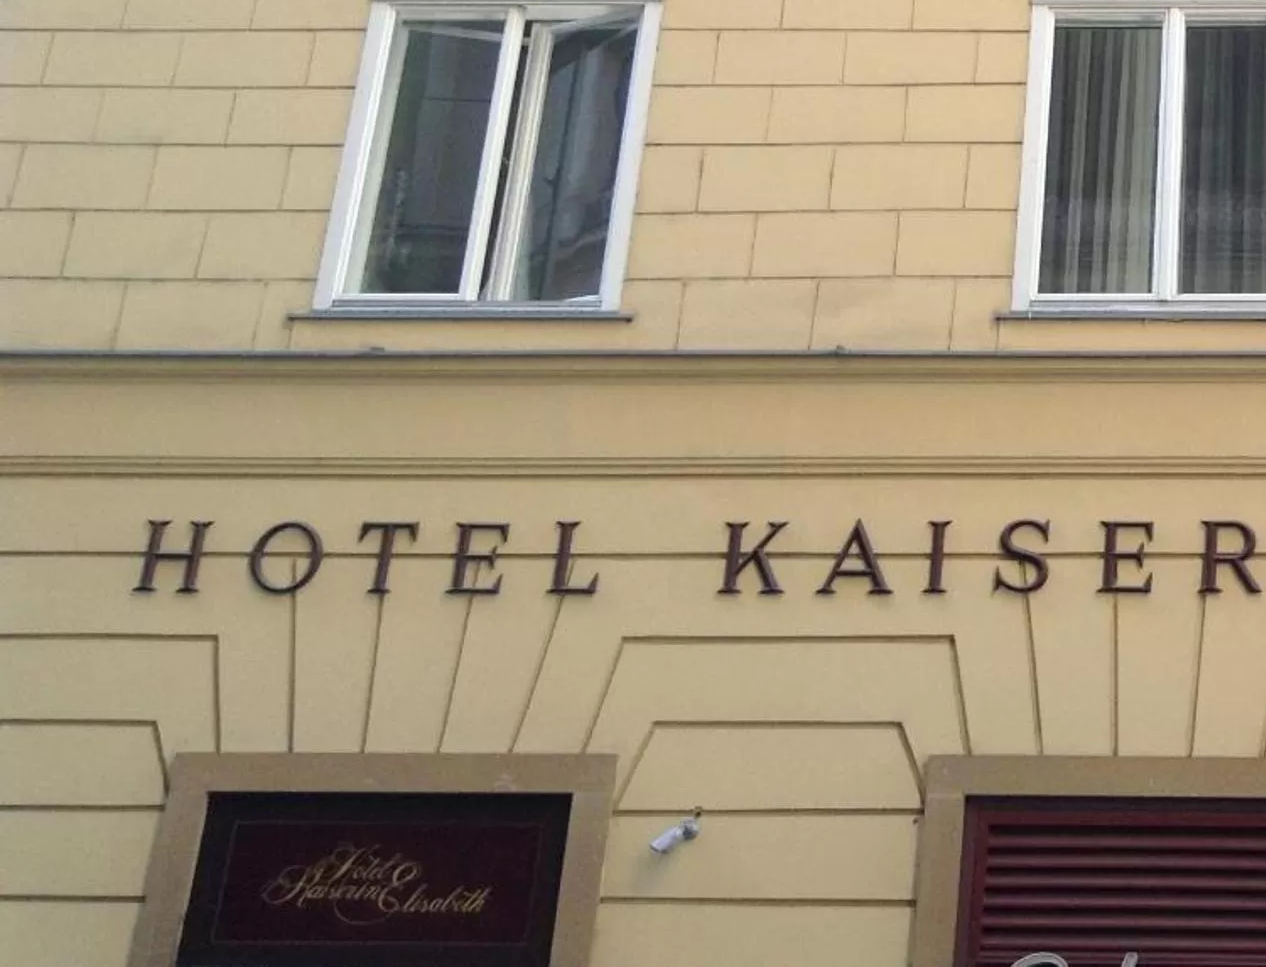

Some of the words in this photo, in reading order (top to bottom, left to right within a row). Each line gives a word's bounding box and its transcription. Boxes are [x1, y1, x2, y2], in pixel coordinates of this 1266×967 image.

[131, 519, 600, 595] HOTEL
[261, 864, 382, 908] Kaiserin
[335, 862, 492, 925] Elisabeth
[318, 842, 402, 882] Hotel
